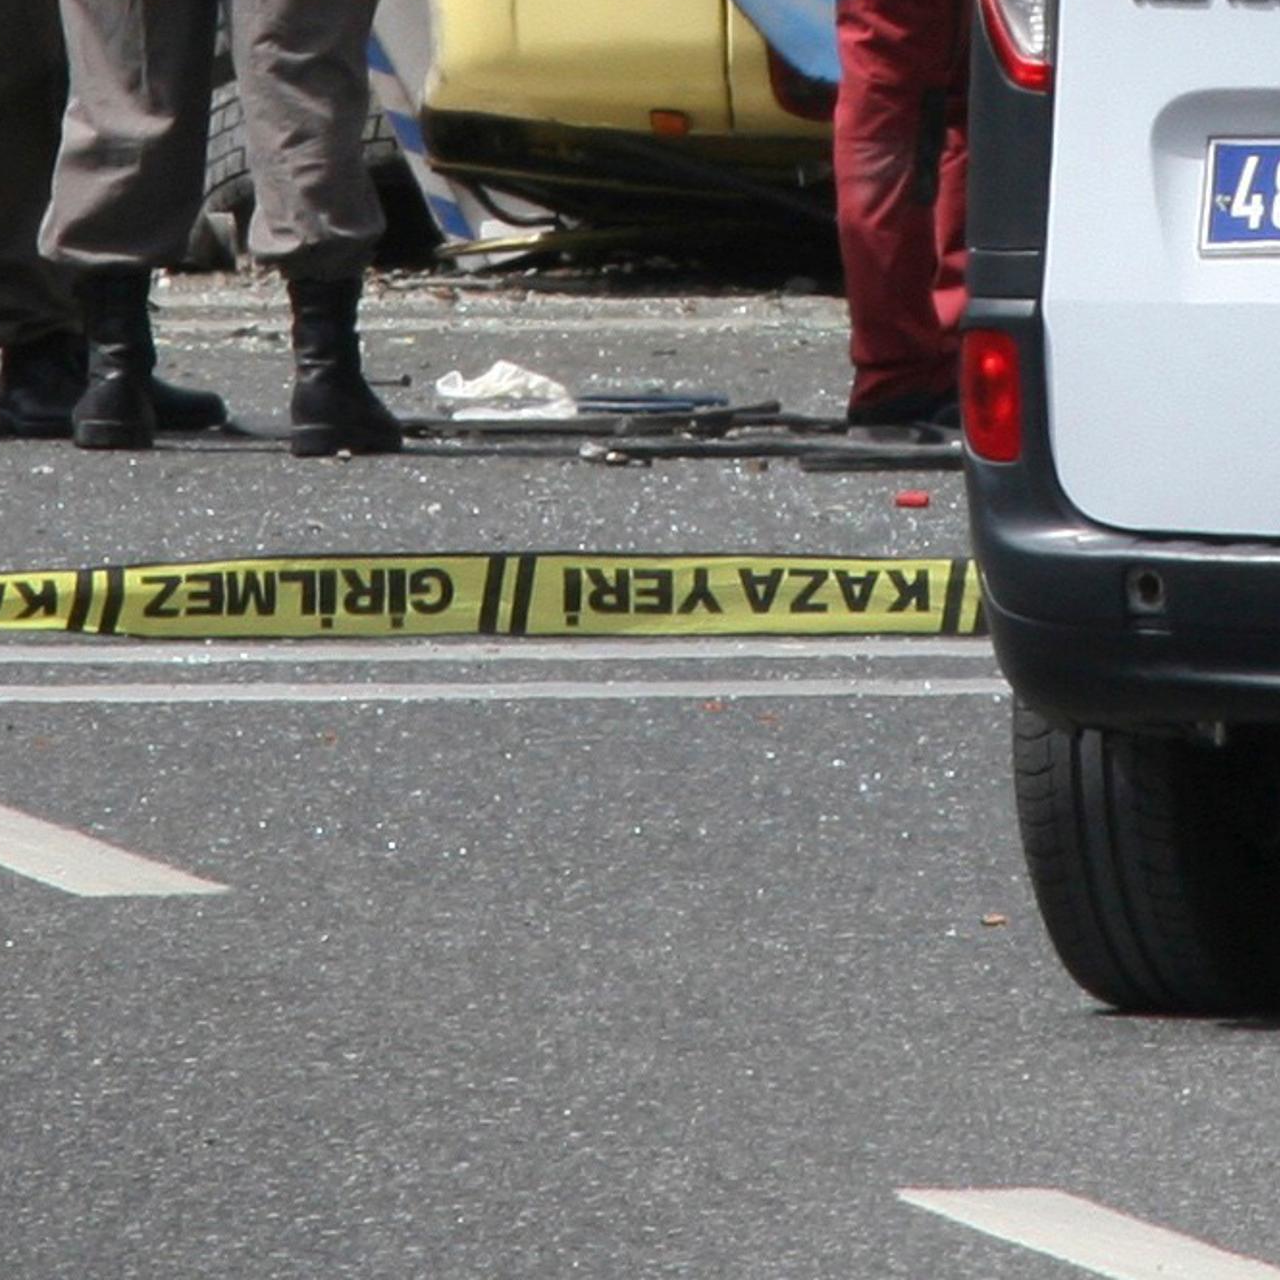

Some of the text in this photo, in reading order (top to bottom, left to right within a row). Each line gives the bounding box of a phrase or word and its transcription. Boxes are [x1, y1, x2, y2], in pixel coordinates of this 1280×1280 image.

[140, 567, 455, 629] GİRİLMEZ
[562, 567, 930, 627] KAZA YERİ
